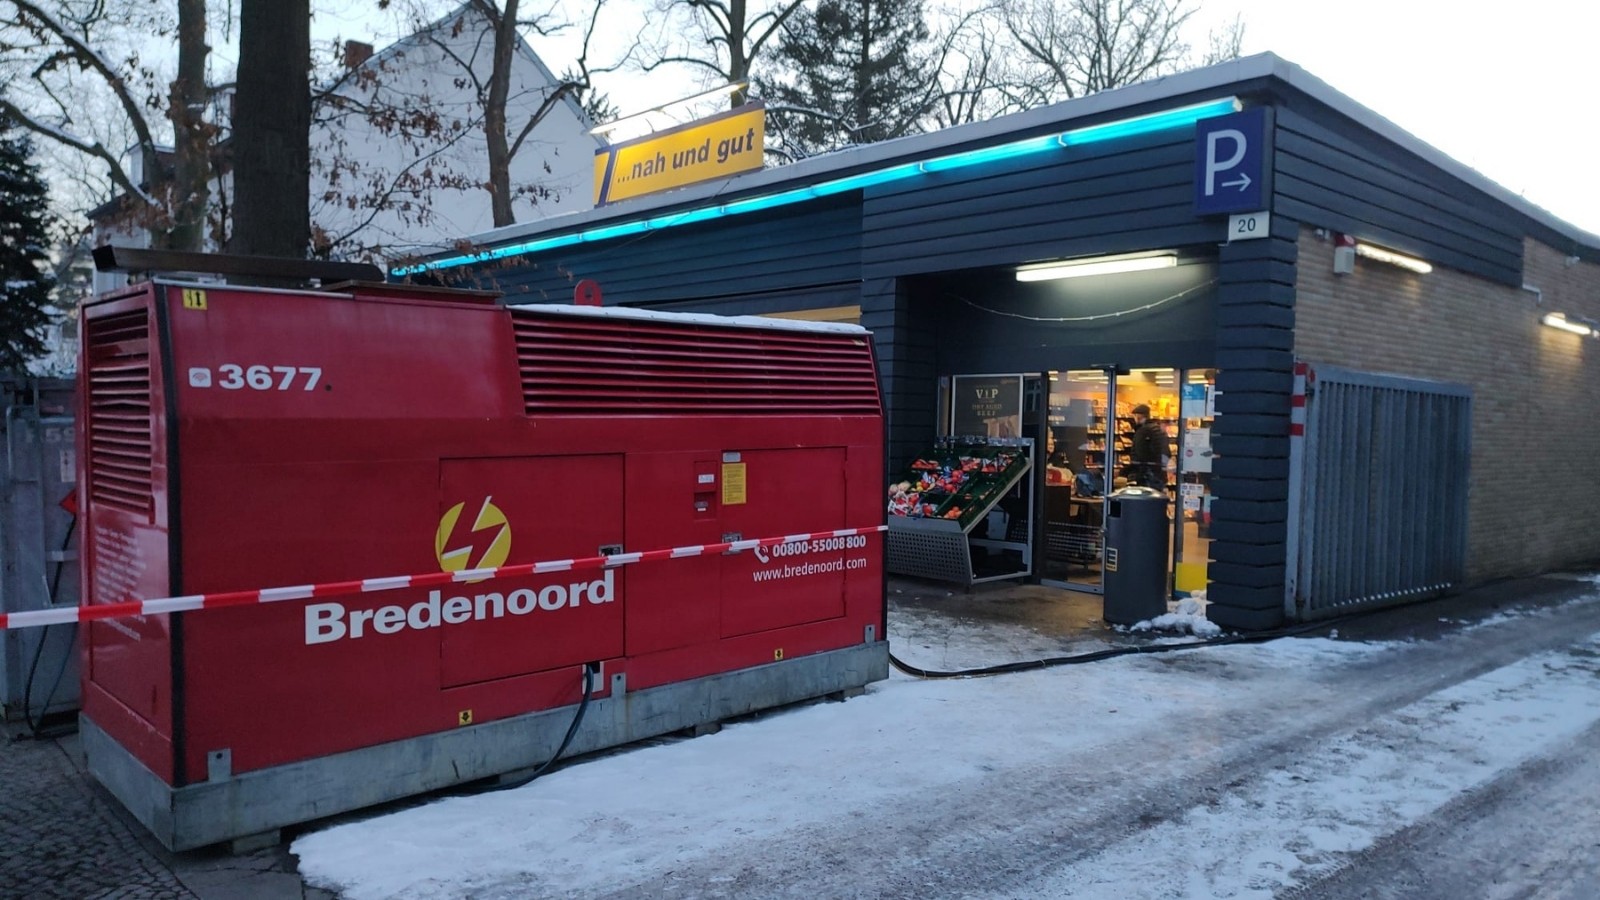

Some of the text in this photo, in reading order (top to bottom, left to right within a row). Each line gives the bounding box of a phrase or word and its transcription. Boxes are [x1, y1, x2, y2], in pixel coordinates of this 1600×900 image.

[672, 138, 710, 169] und
[717, 127, 755, 164] gut
[1205, 129, 1247, 196] P
[1238, 217, 1256, 233] 20
[219, 363, 322, 391] 3677
[975, 388, 999, 399] VIP
[753, 557, 867, 582] www.bredenoord.com
[305, 569, 615, 645] Bredenoord
